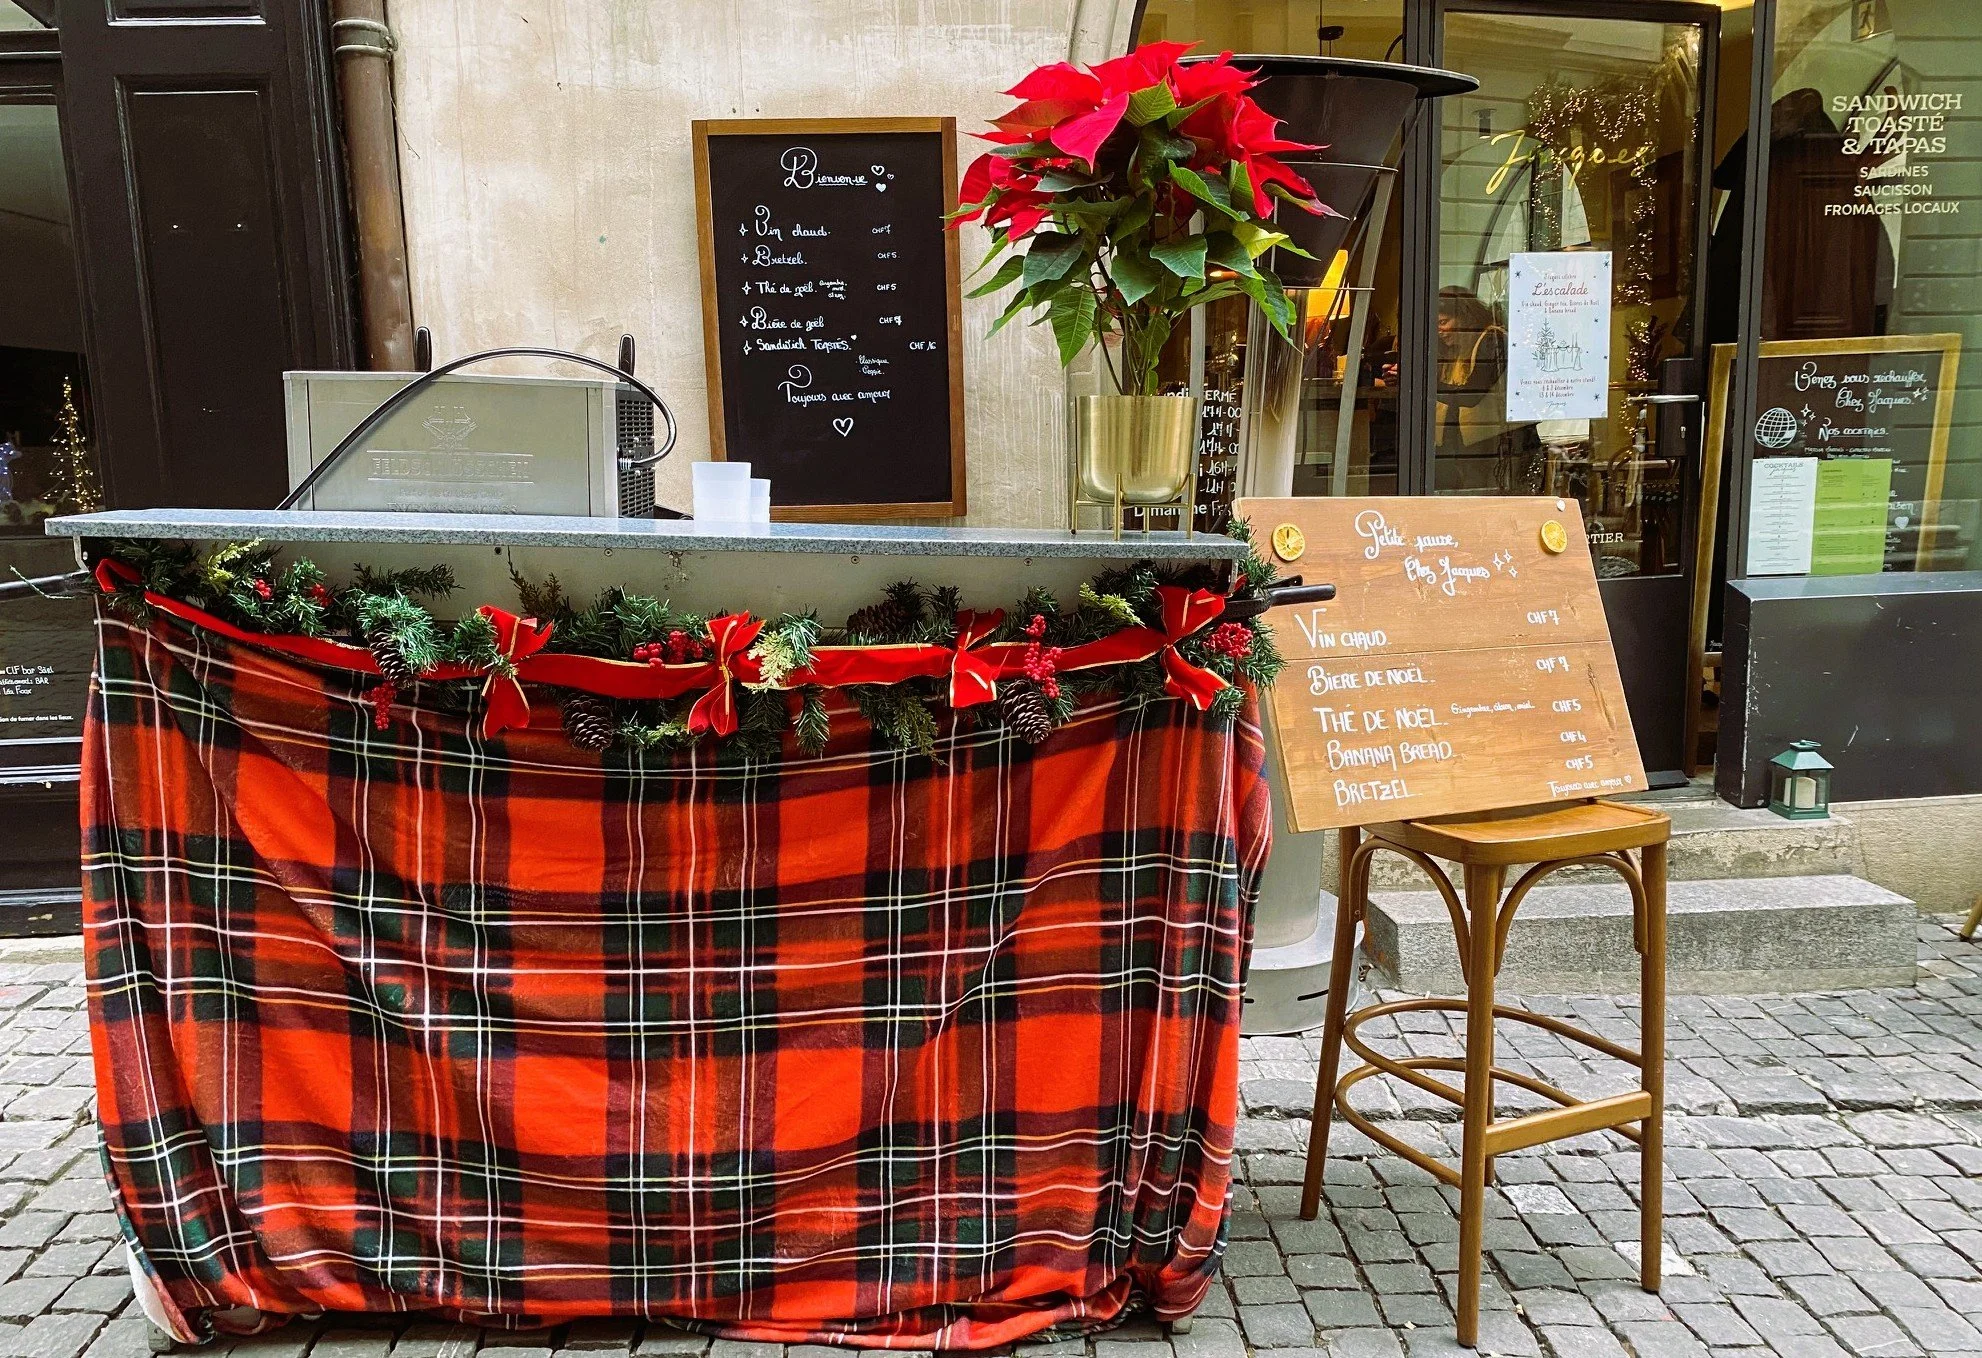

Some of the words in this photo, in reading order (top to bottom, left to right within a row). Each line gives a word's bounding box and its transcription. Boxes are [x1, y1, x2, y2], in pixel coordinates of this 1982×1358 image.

[1832, 93, 1962, 112] SANDWICH
[1848, 112, 1944, 133] TOASTÉ
[1841, 138, 1861, 155] &
[1870, 136, 1946, 155] TAPAS
[1860, 166, 1929, 178] SARDINES
[1854, 184, 1932, 197] SAUCISSON
[1824, 203, 1901, 216] FROMAGES
[1904, 202, 1960, 214] LOCAUX
[755, 204, 783, 241] Vin
[755, 281, 777, 294] Thé
[780, 283, 793, 293] de
[1532, 282, 1589, 296] L'escalade
[790, 319, 803, 329] de
[831, 392, 854, 401] avec
[1205, 387, 1237, 403] ERMÉ
[372, 457, 529, 479] FELDSCÖSSCHEN
[1404, 555, 1437, 585] Chez
[35, 677, 49, 685] BAR
[1364, 670, 1386, 687] DE
[1362, 709, 1389, 733] DE
